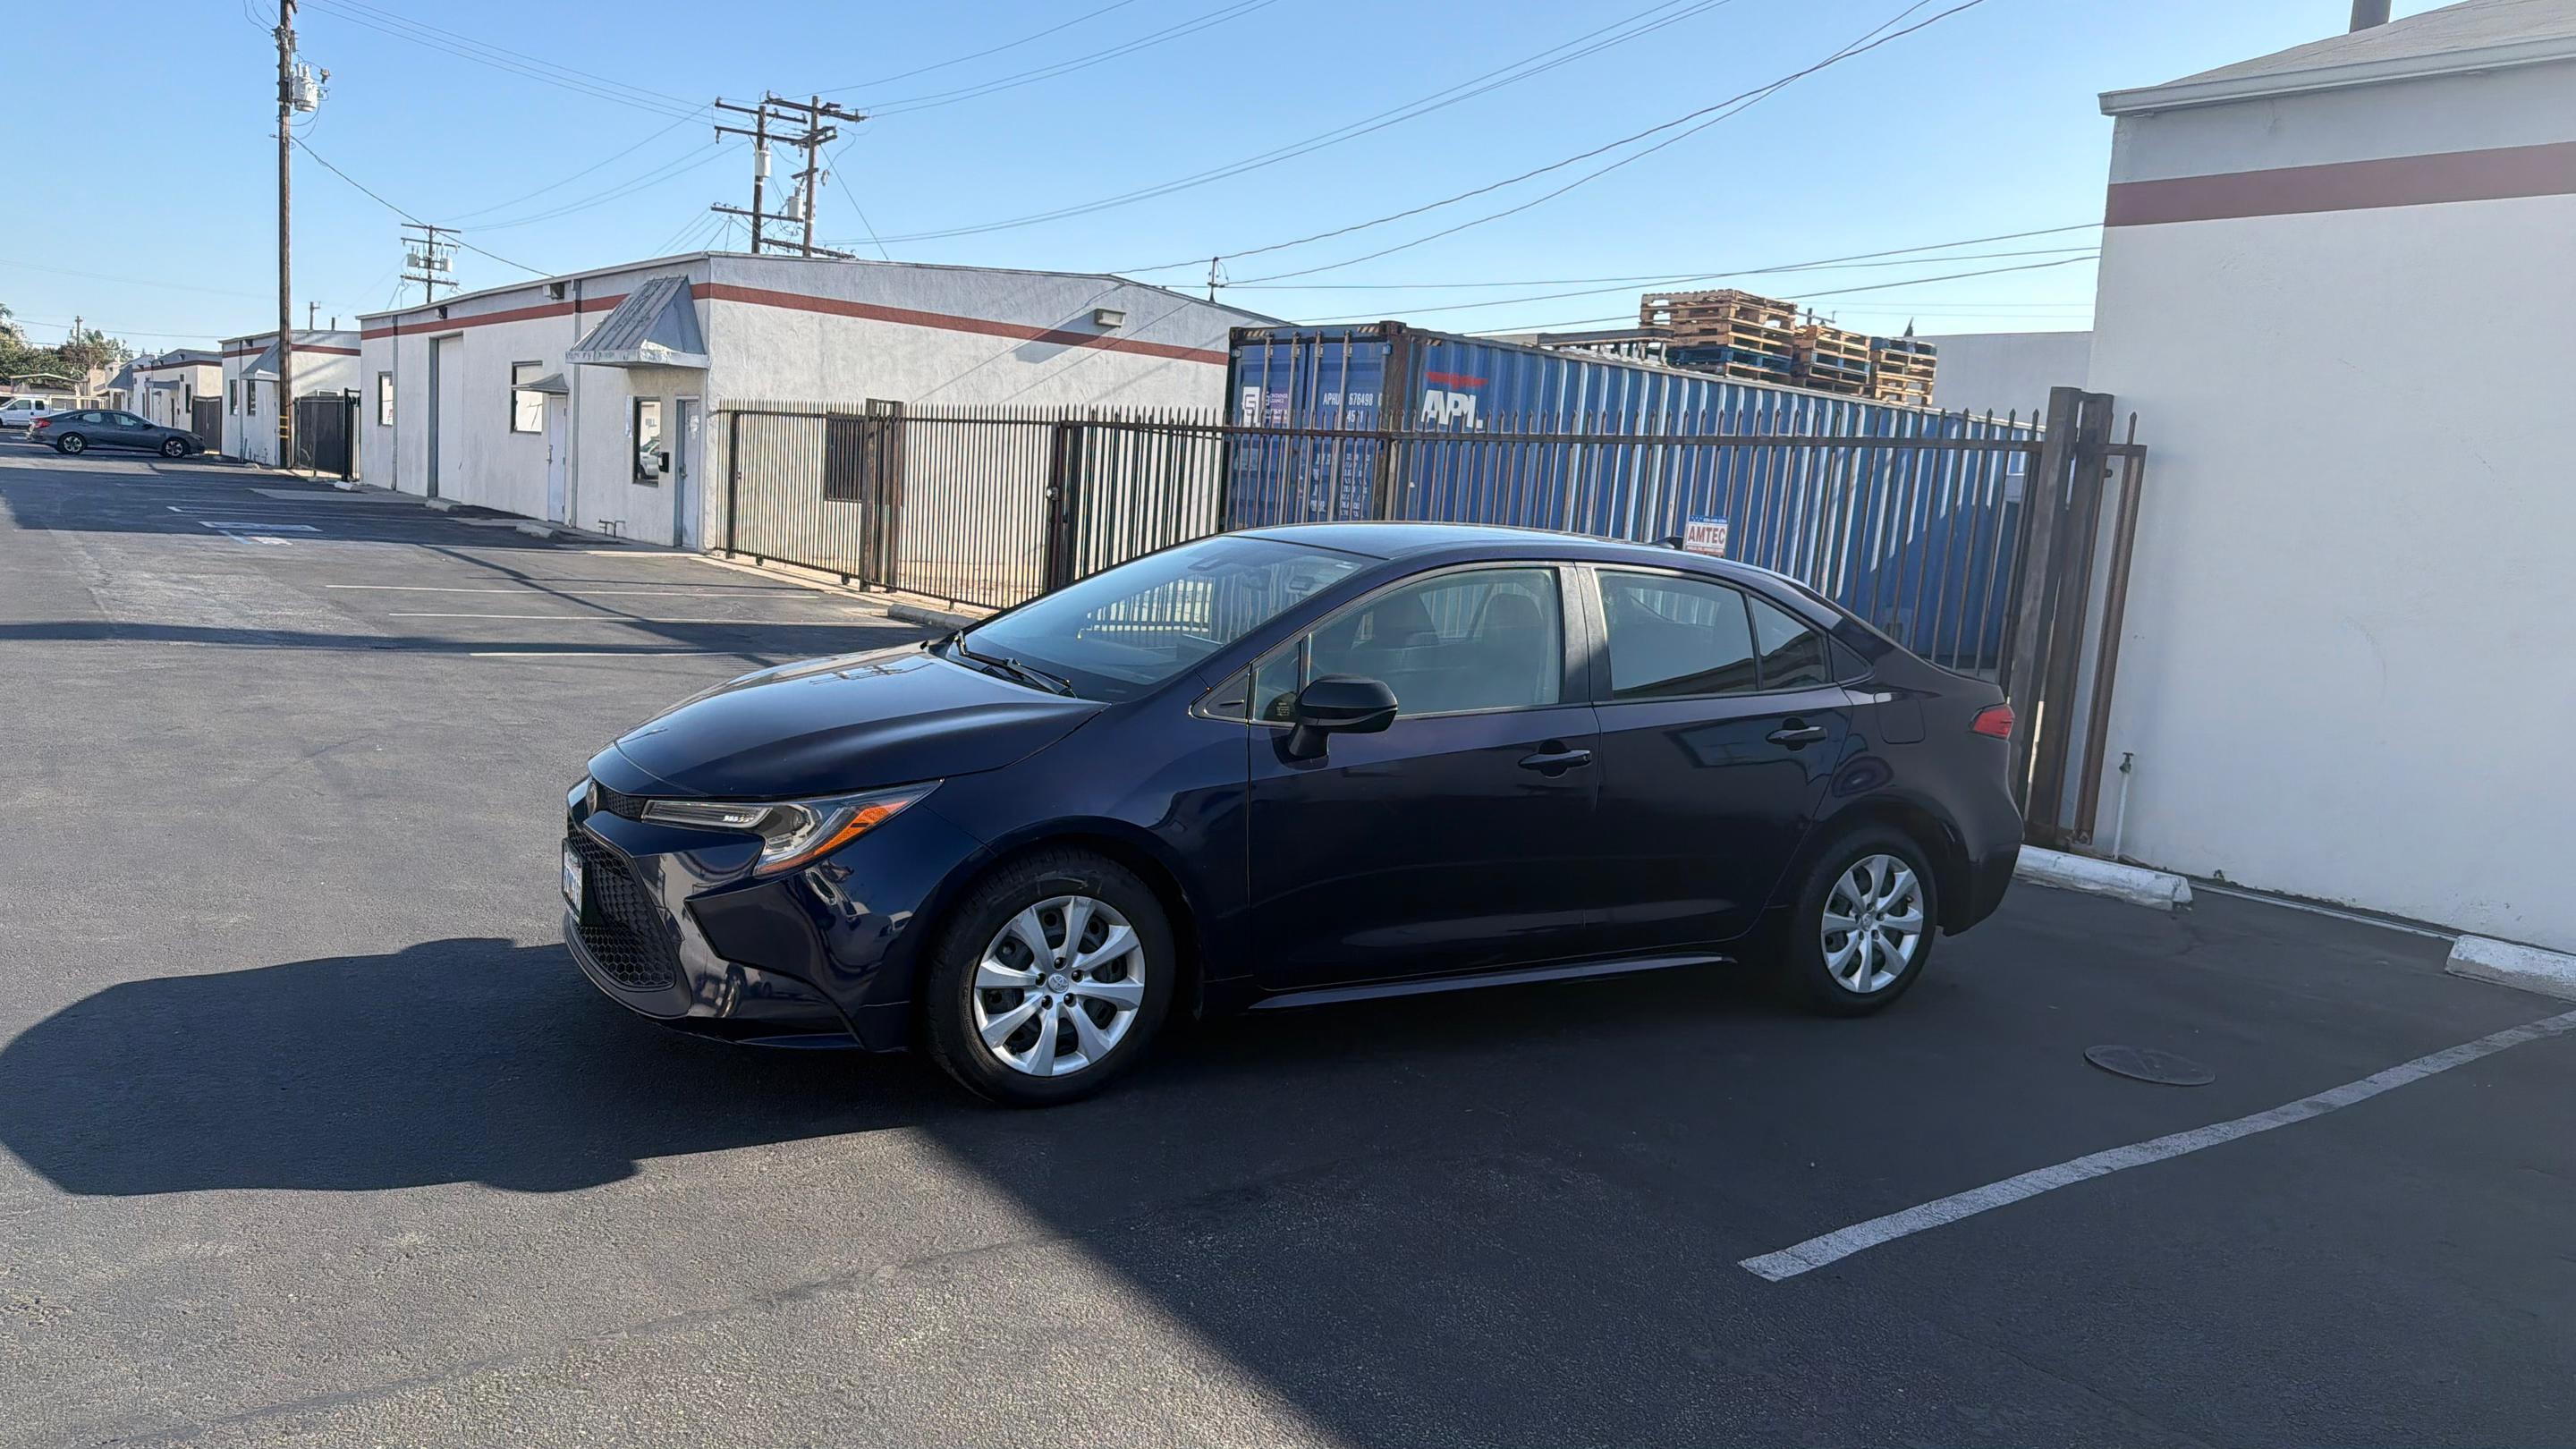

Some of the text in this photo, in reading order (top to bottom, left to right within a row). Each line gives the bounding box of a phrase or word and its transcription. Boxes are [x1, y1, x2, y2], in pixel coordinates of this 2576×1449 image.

[1323, 392, 1341, 406] APHU
[1349, 392, 1374, 406] 676498
[1346, 409, 1364, 423] 451
[1688, 526, 1725, 545] AMTEC
